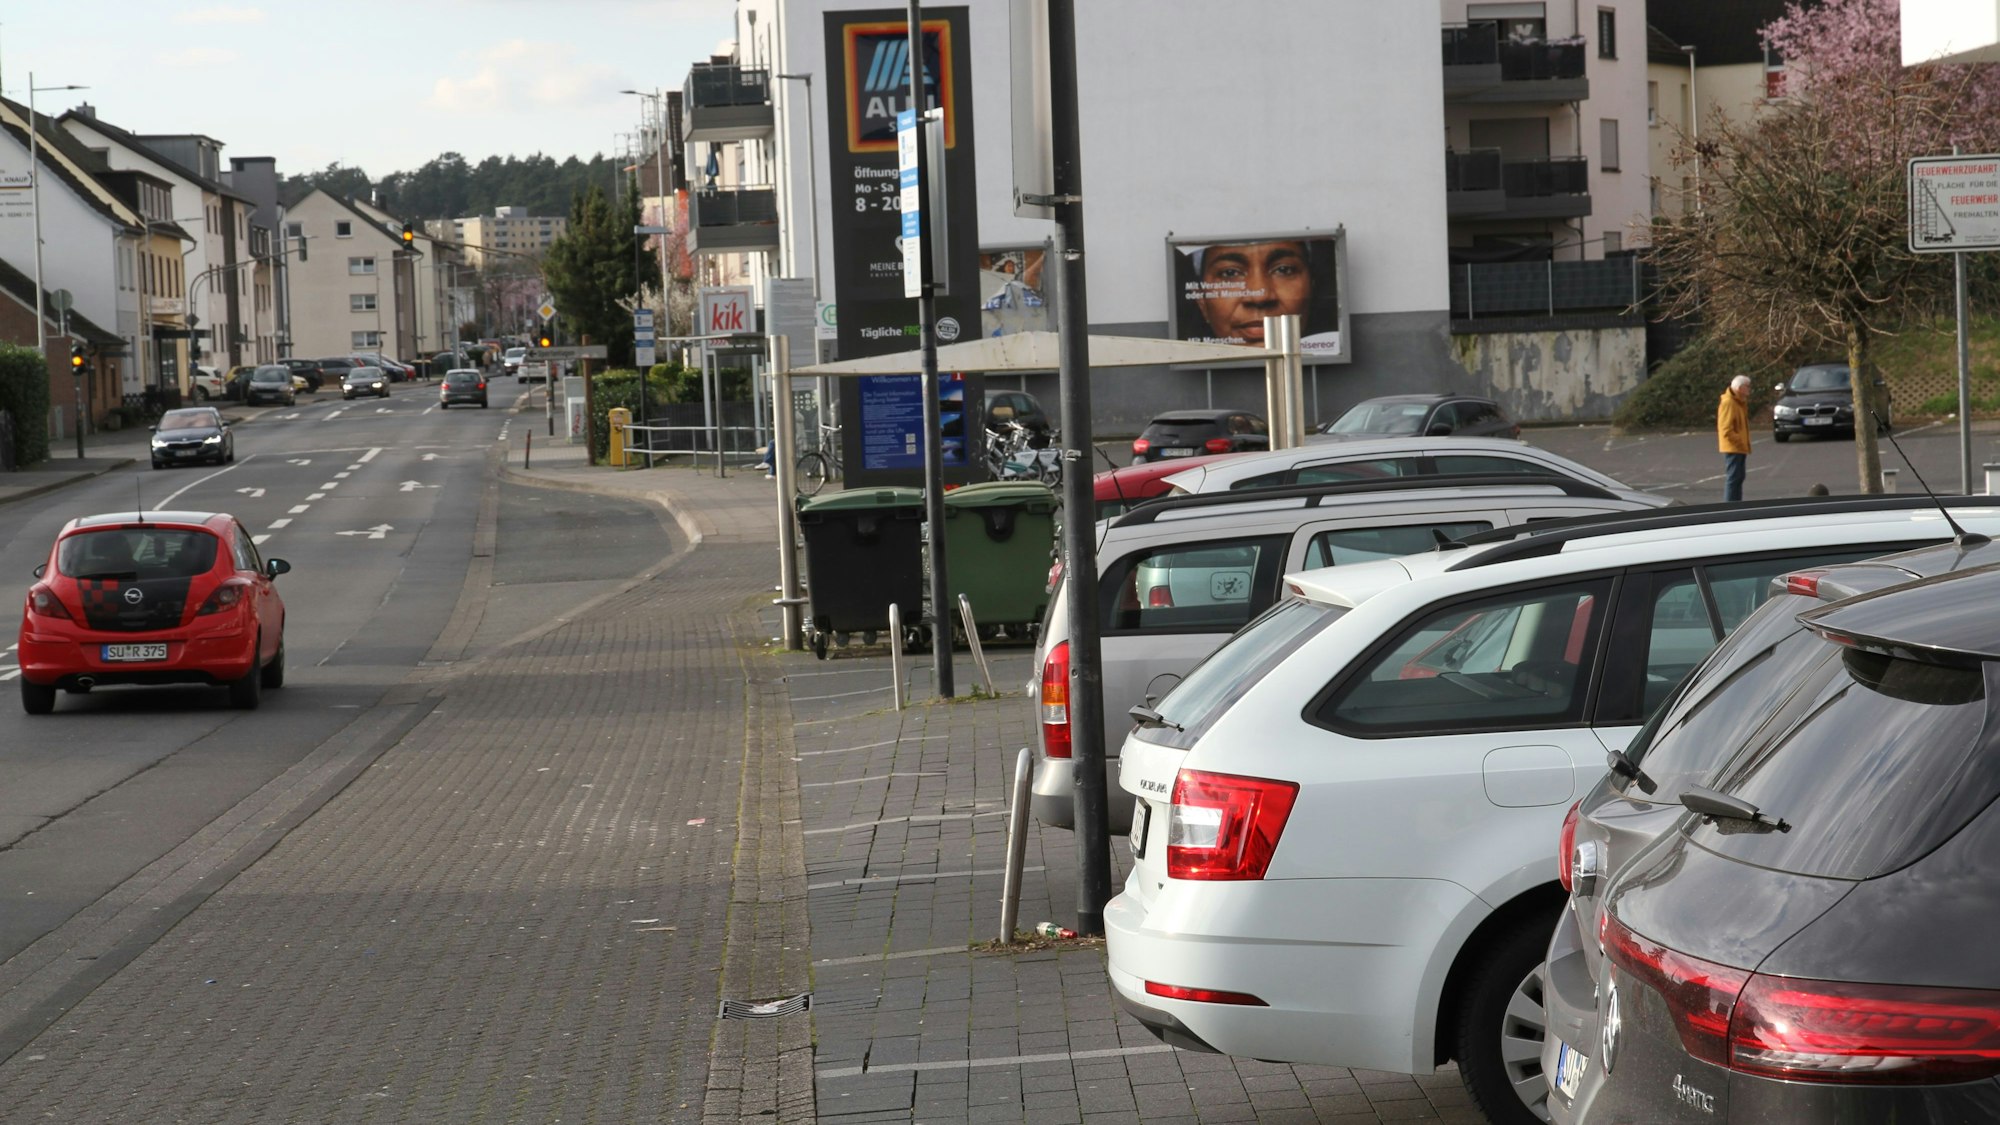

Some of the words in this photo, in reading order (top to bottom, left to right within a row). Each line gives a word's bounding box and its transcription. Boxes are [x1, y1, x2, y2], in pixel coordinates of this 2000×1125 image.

[866, 94, 935, 118] ALI
[854, 166, 900, 179] Öffnung
[1916, 164, 1998, 176] FEUERWEHRZUFAHRT
[855, 184, 872, 193] Mo
[881, 183, 895, 192] Sa
[1969, 180, 1984, 188] FÜR
[855, 198, 867, 212] 8
[882, 197, 901, 211] 20
[1951, 194, 1998, 205] FEUERWEHR
[1953, 210, 1999, 218] FREIHALTEN
[870, 262, 897, 271] MEINE
[1185, 282, 1199, 290] Mit
[1200, 281, 1246, 290] Verachtung
[1185, 291, 1203, 299] oder
[1205, 290, 1219, 298] mit
[1220, 288, 1265, 298] Menschen?
[860, 326, 902, 339] Tägliche
[903, 325, 921, 336] FRIS
[109, 646, 125, 658] SU
[132, 646, 140, 657] R
[143, 645, 165, 657] 375
